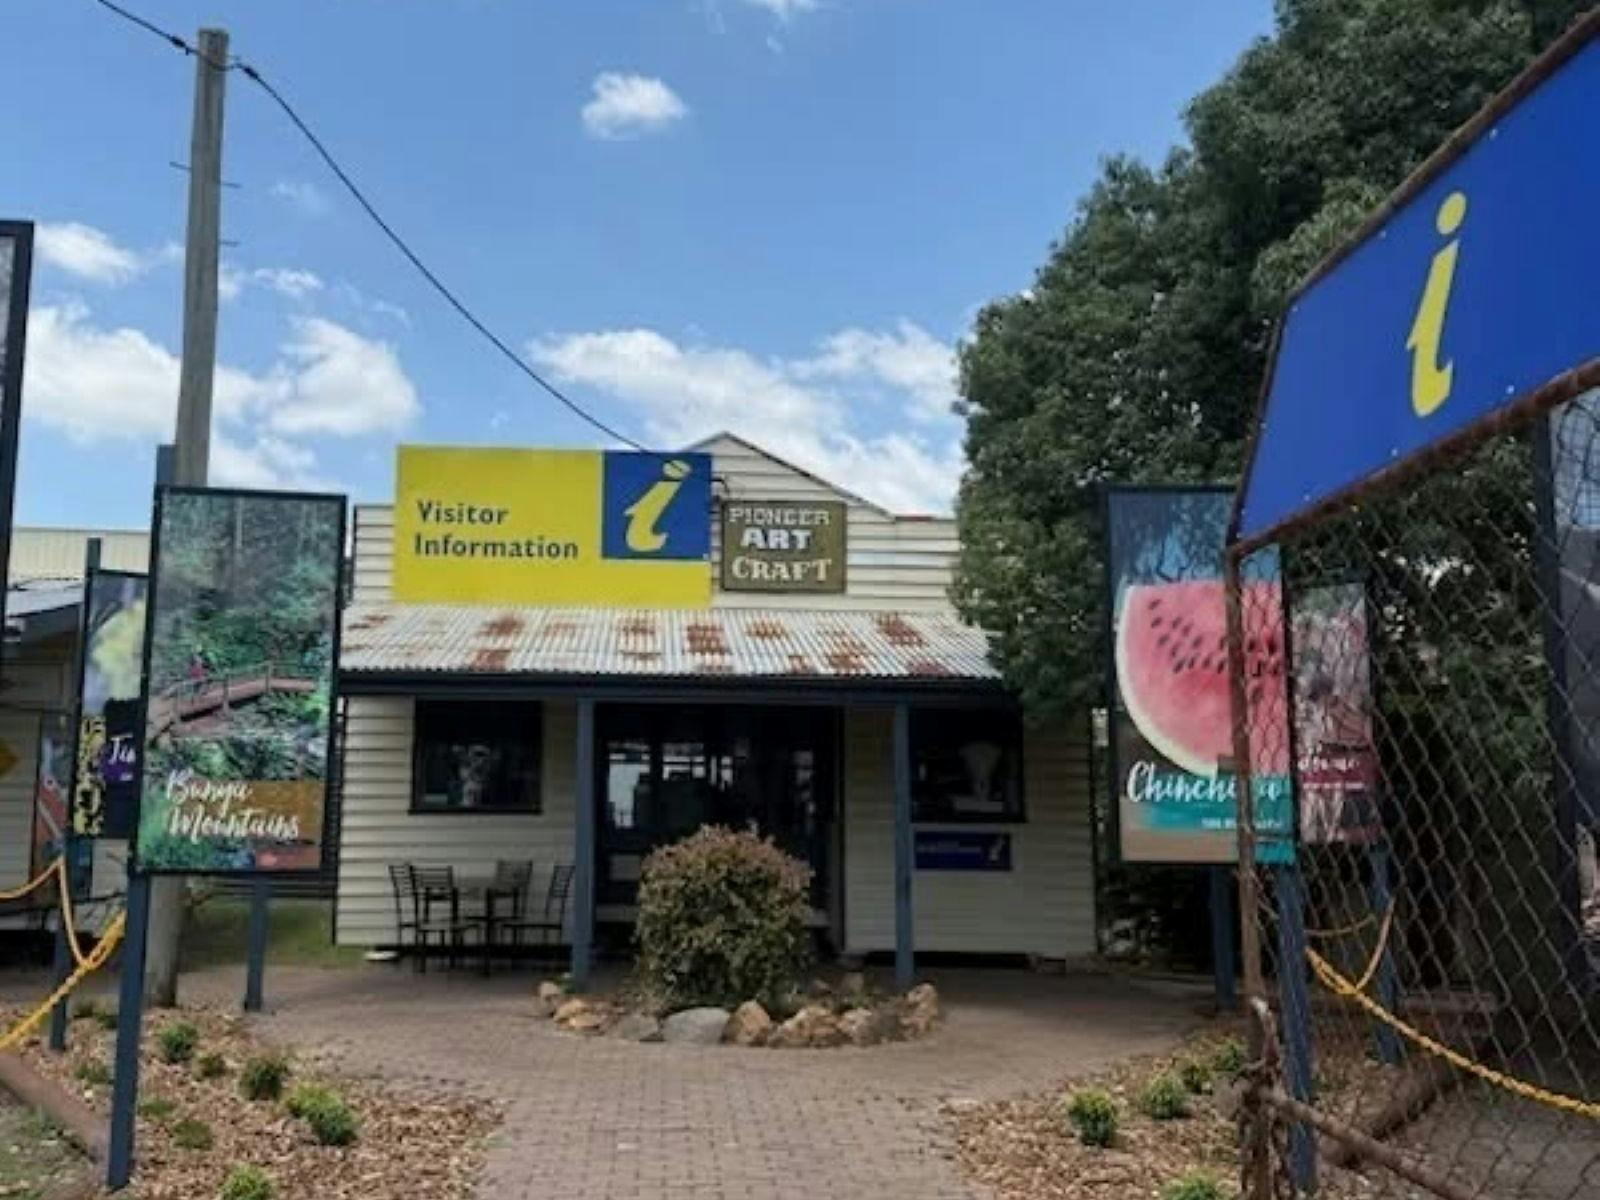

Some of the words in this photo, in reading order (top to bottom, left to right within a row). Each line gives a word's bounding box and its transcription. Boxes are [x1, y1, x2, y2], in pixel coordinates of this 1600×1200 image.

[1406, 191, 1467, 417] i
[416, 499, 510, 526] Visitor
[622, 459, 692, 553] i
[728, 507, 830, 526] PIONEER
[414, 533, 580, 560] Information
[740, 527, 811, 550] ART
[731, 555, 832, 580] CRAFT
[1127, 760, 1282, 803] Chinchi
